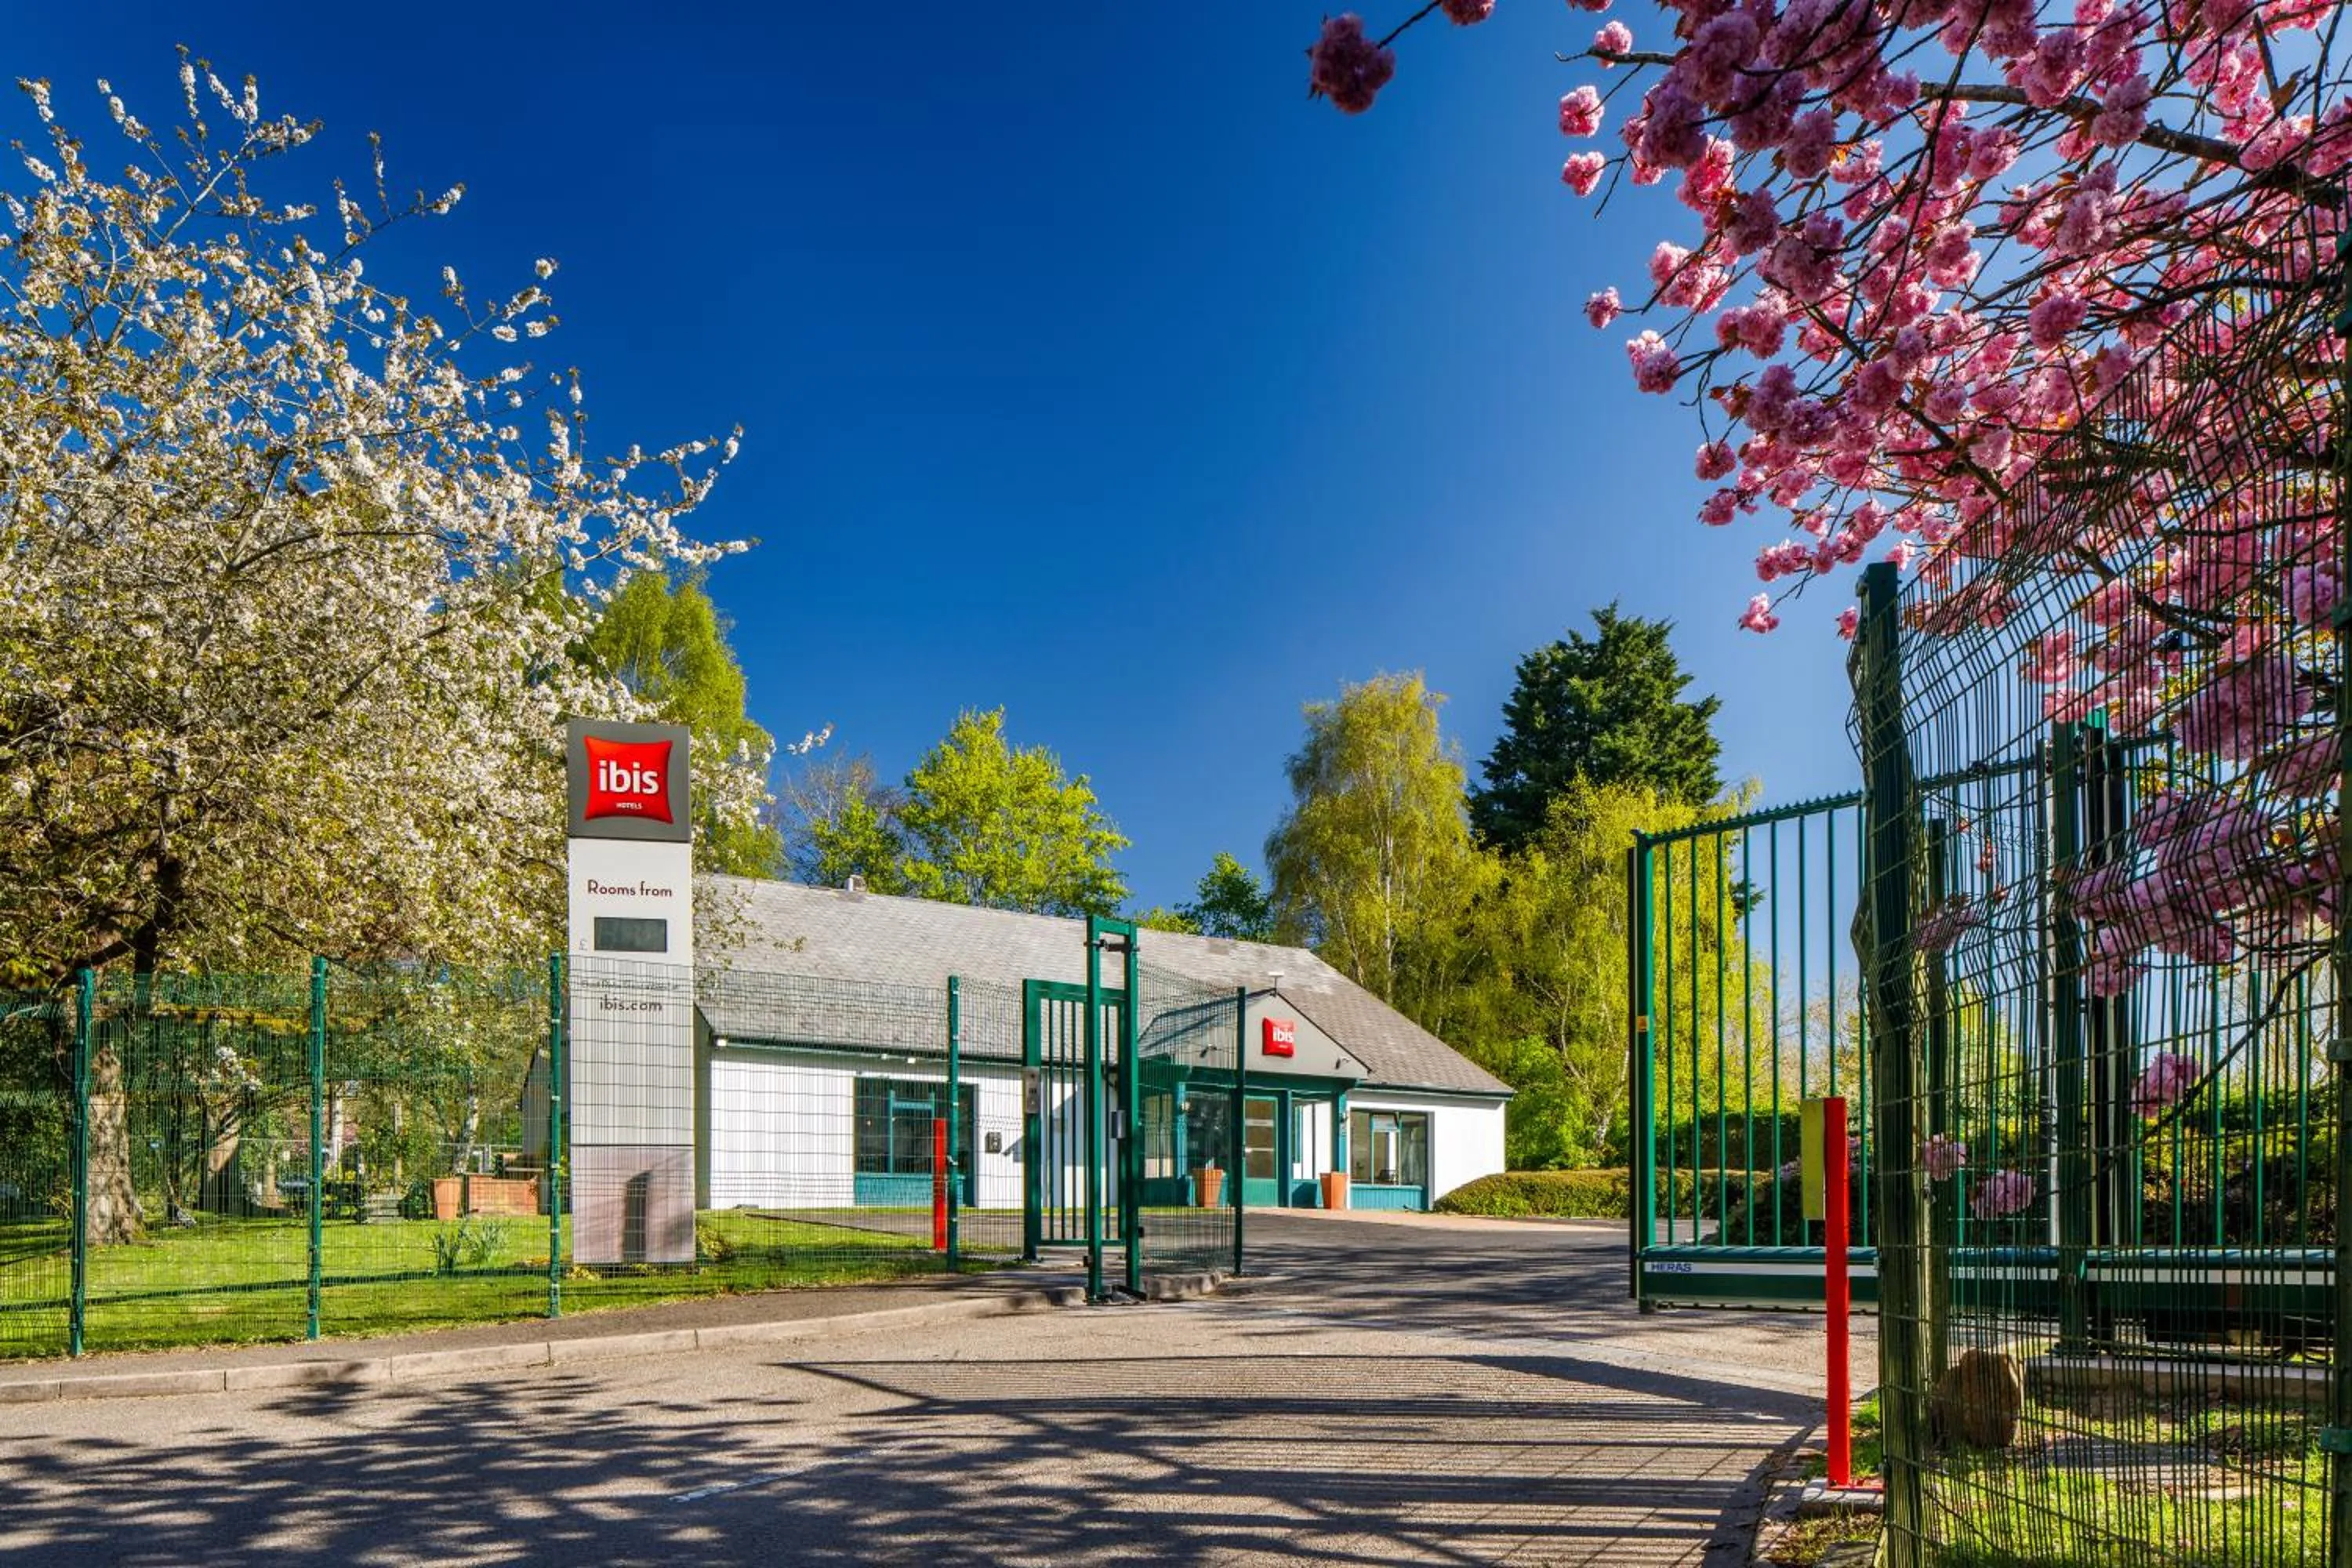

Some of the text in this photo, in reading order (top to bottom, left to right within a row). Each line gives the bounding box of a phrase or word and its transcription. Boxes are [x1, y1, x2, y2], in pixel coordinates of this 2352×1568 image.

[599, 760, 659, 794] ibis
[587, 879, 672, 896] Rooms from
[600, 993, 662, 1011] ibis.com
[1272, 1026, 1294, 1043] ibis
[1651, 1263, 1692, 1272] HERAS
